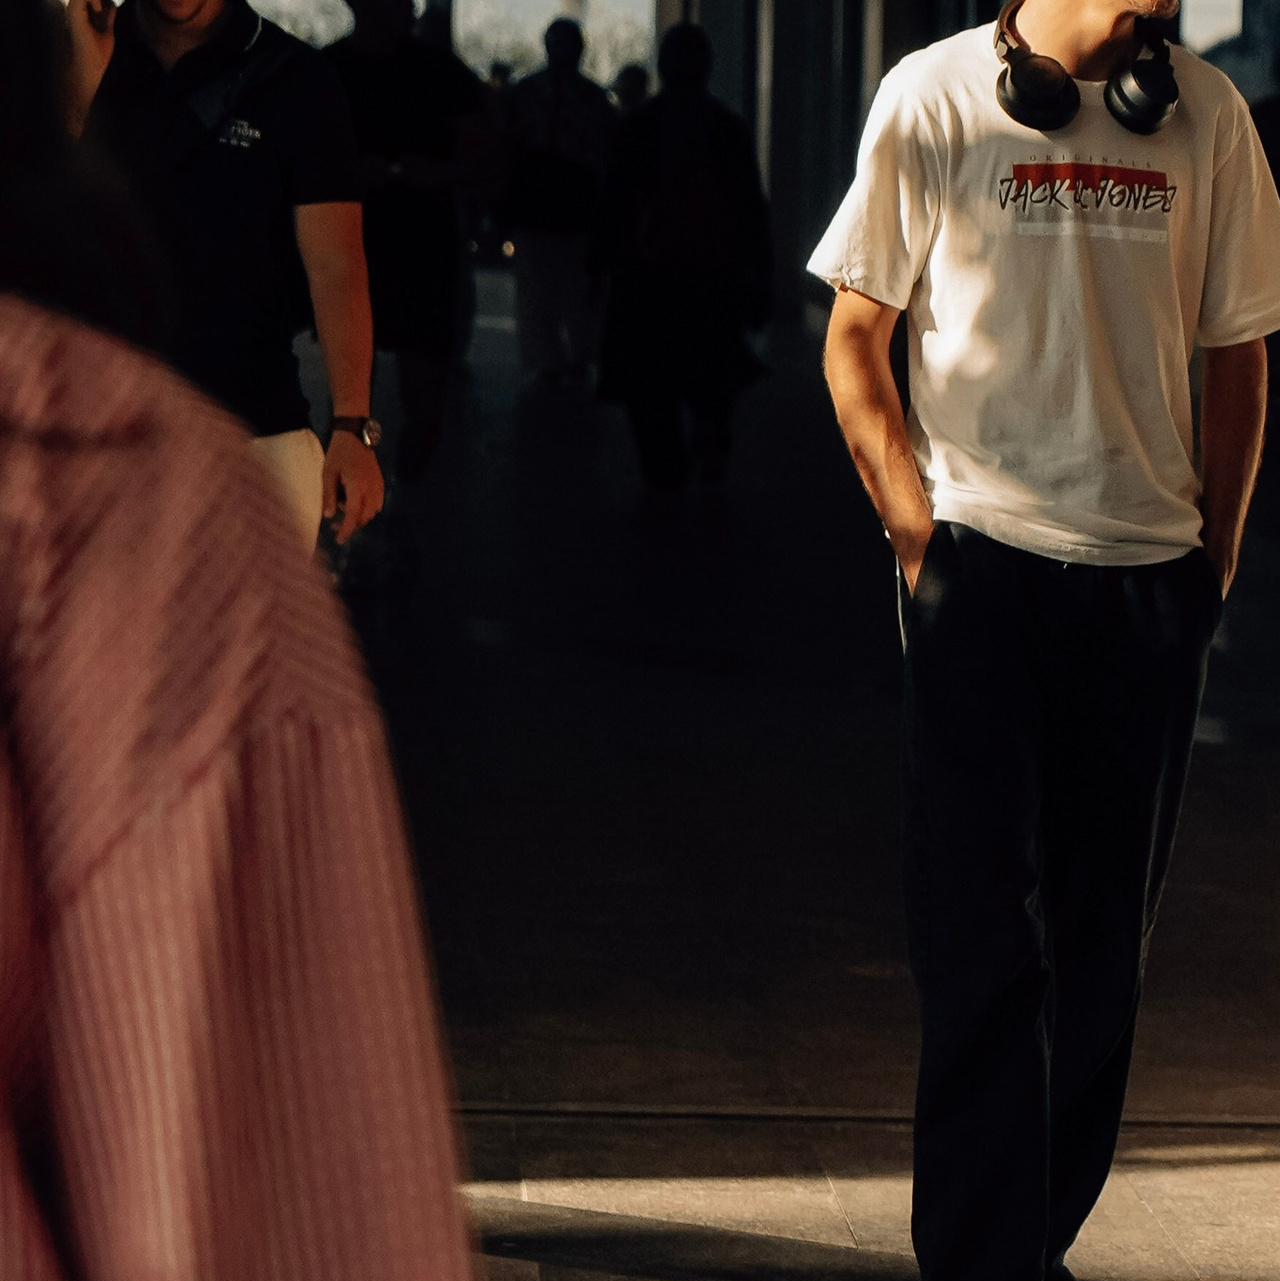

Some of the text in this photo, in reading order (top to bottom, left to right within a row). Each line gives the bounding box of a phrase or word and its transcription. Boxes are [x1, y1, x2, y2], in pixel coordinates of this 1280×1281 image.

[1028, 153, 1152, 169] ORIGINALS
[999, 177, 1178, 213] JACK & JONES
